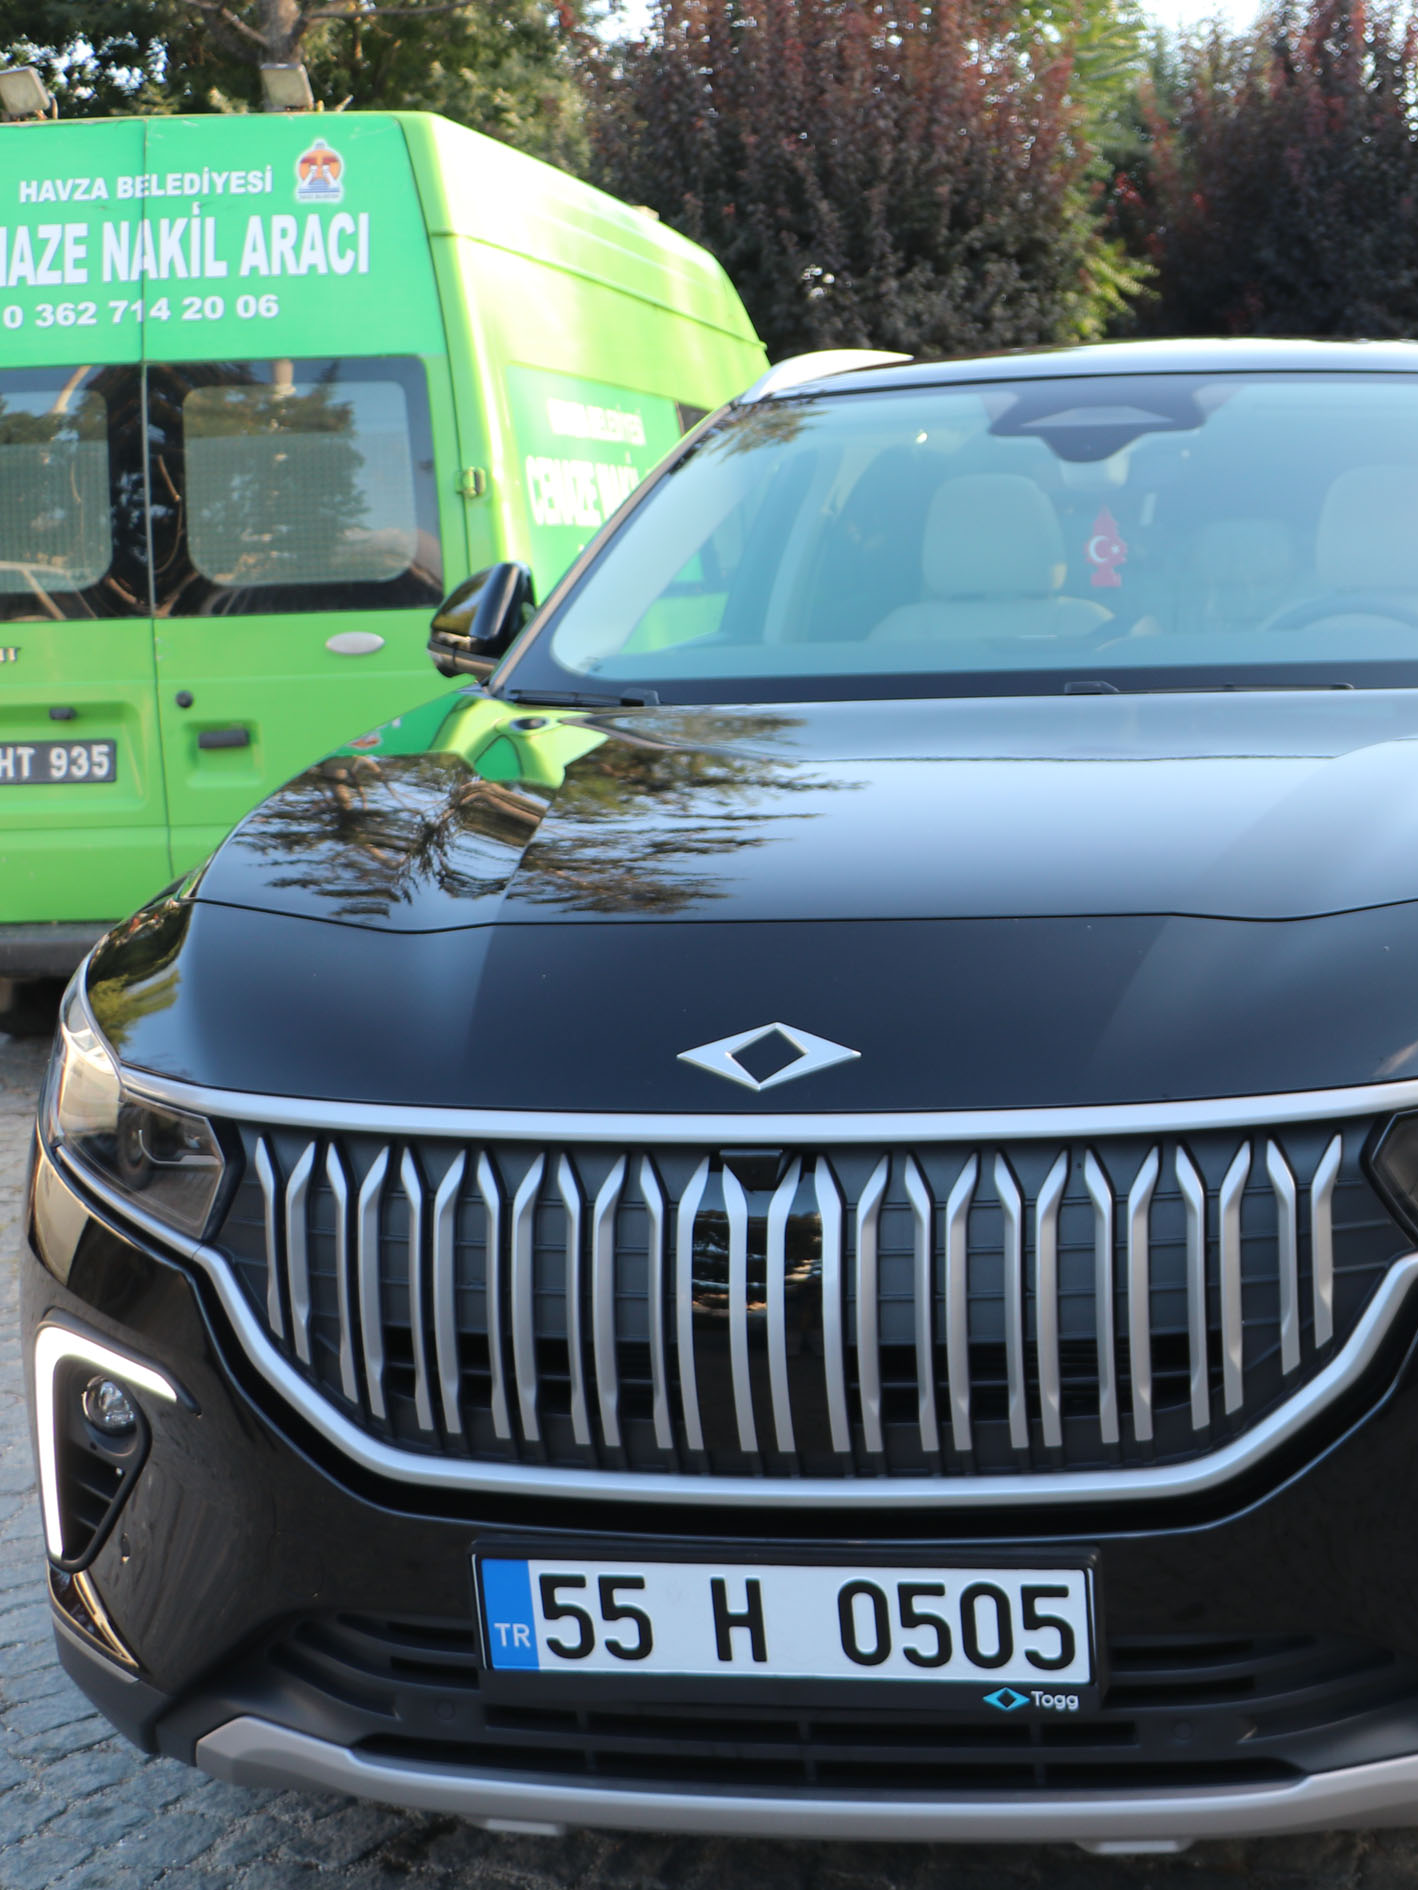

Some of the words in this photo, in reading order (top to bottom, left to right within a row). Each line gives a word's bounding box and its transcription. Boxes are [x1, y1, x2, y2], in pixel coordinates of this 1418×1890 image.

[19, 177, 109, 203] HAVZA
[116, 165, 273, 199] BELEDİYESİ
[102, 202, 228, 282] NAKİL
[239, 212, 370, 276] ARACI
[3, 305, 23, 329] 0
[35, 301, 97, 328] 362
[109, 297, 171, 324] 714
[182, 295, 225, 321] 20
[236, 294, 279, 319] 06
[50, 744, 110, 778] 935
[494, 1623, 531, 1648] TR
[539, 1572, 653, 1660] 55
[710, 1576, 768, 1662] H
[837, 1578, 1076, 1671] 0505
[1031, 1690, 1079, 1710] Togg
